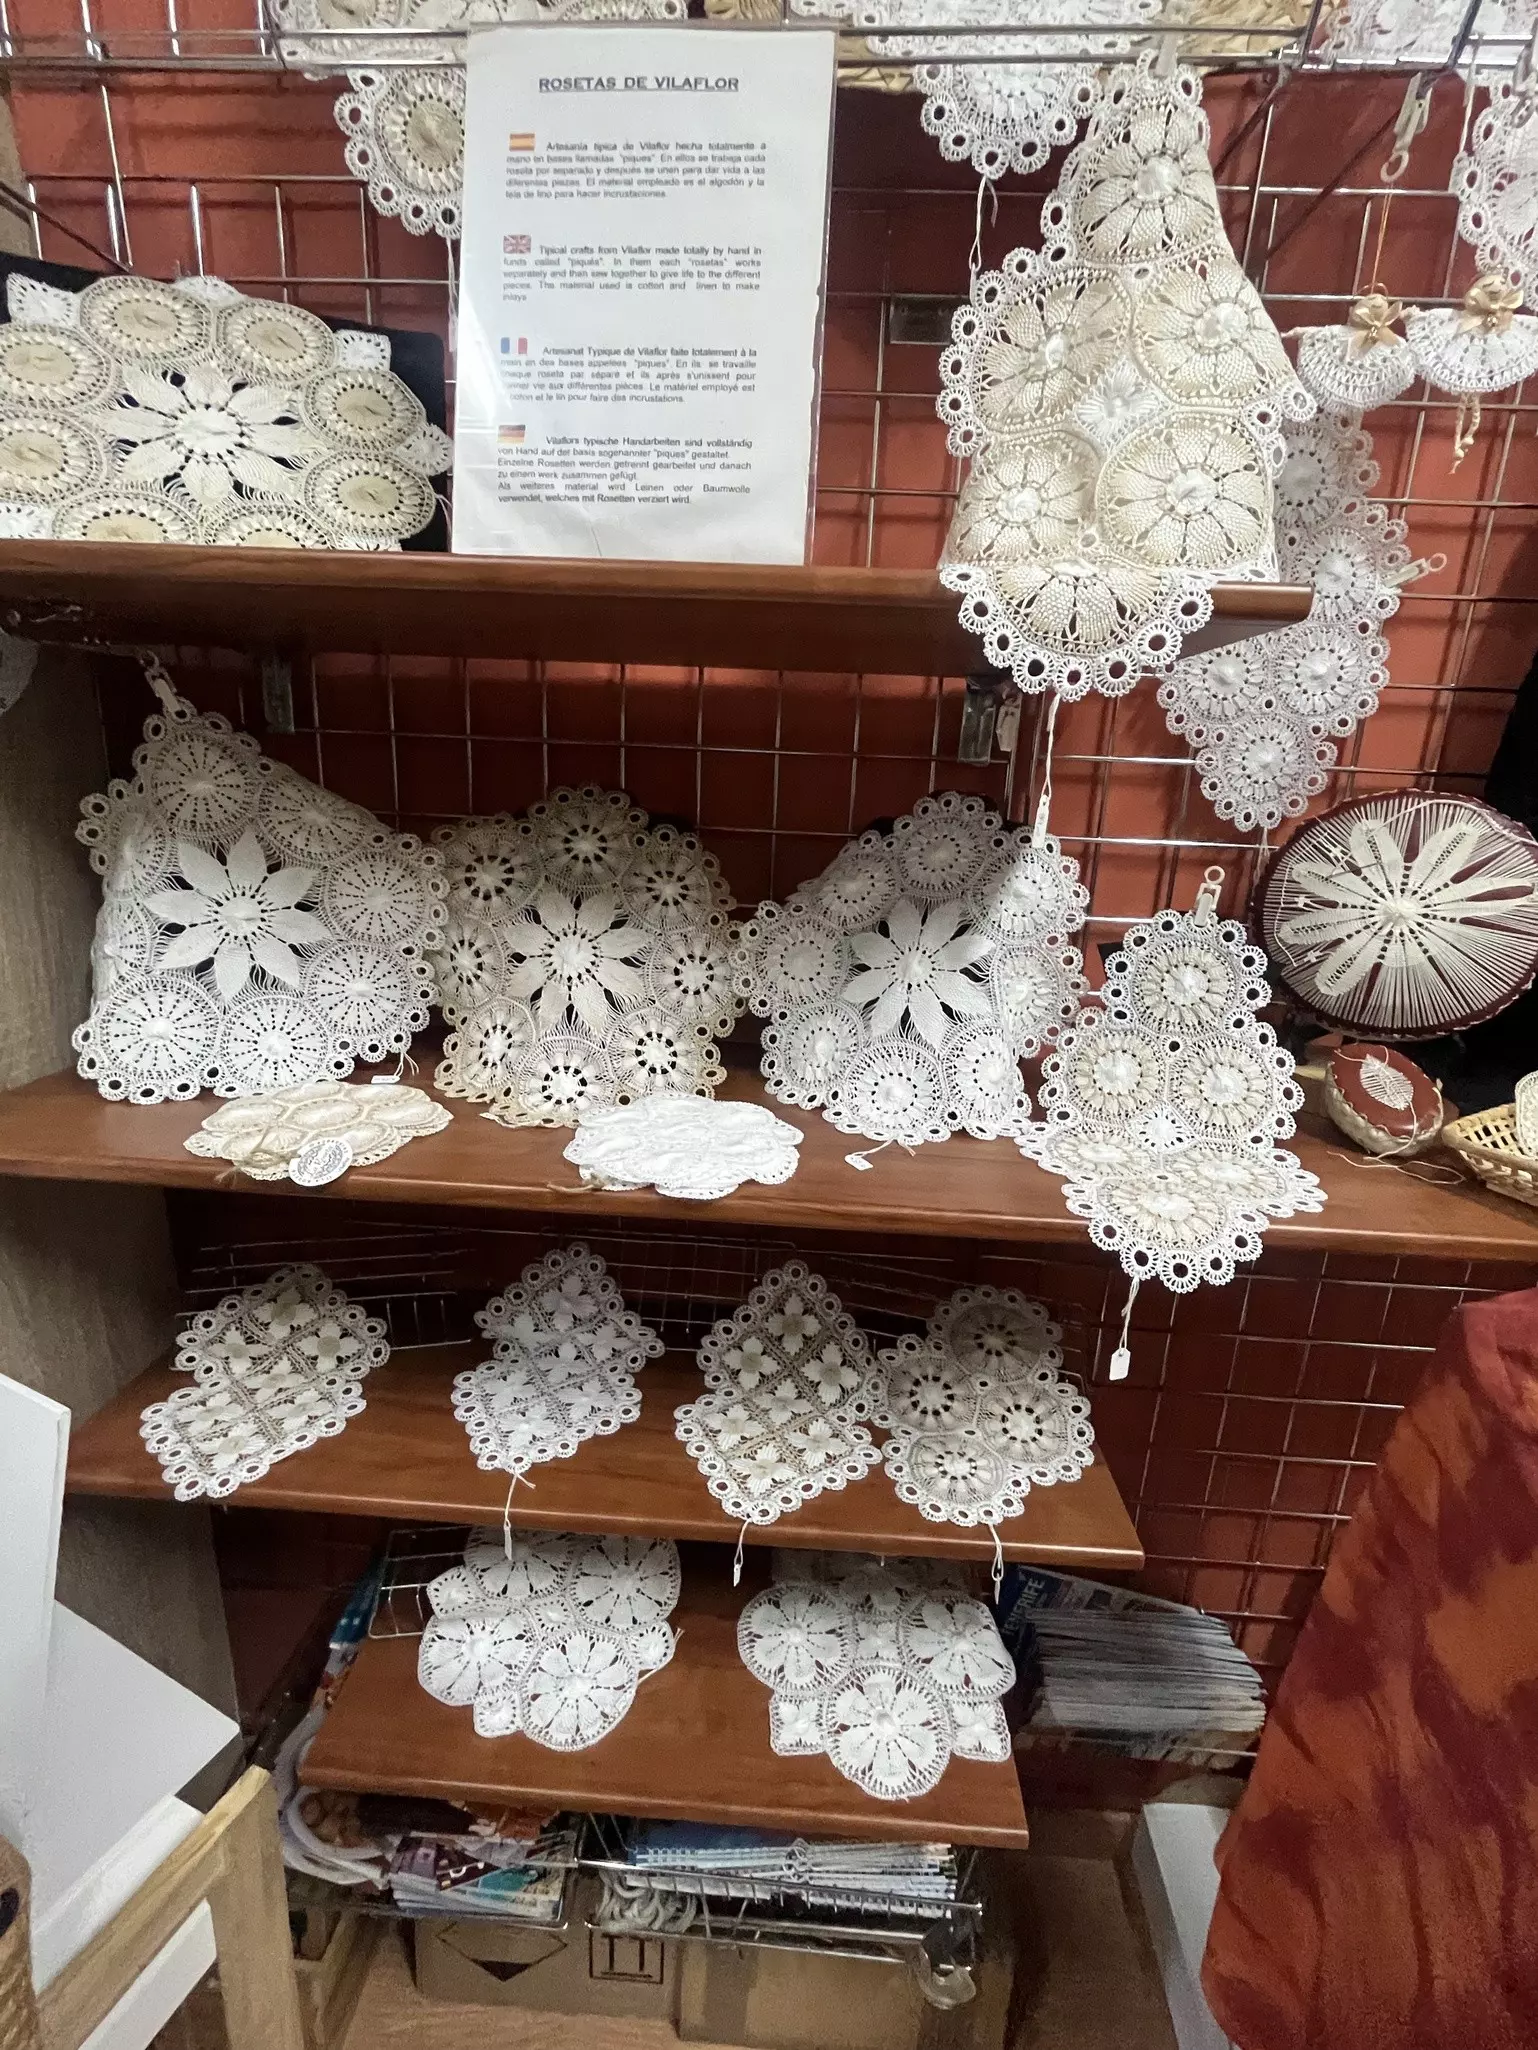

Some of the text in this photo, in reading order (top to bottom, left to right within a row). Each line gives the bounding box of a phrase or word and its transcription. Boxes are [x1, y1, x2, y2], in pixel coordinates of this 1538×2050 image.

[539, 76, 738, 90] ROSETAS DE VILAFLOR
